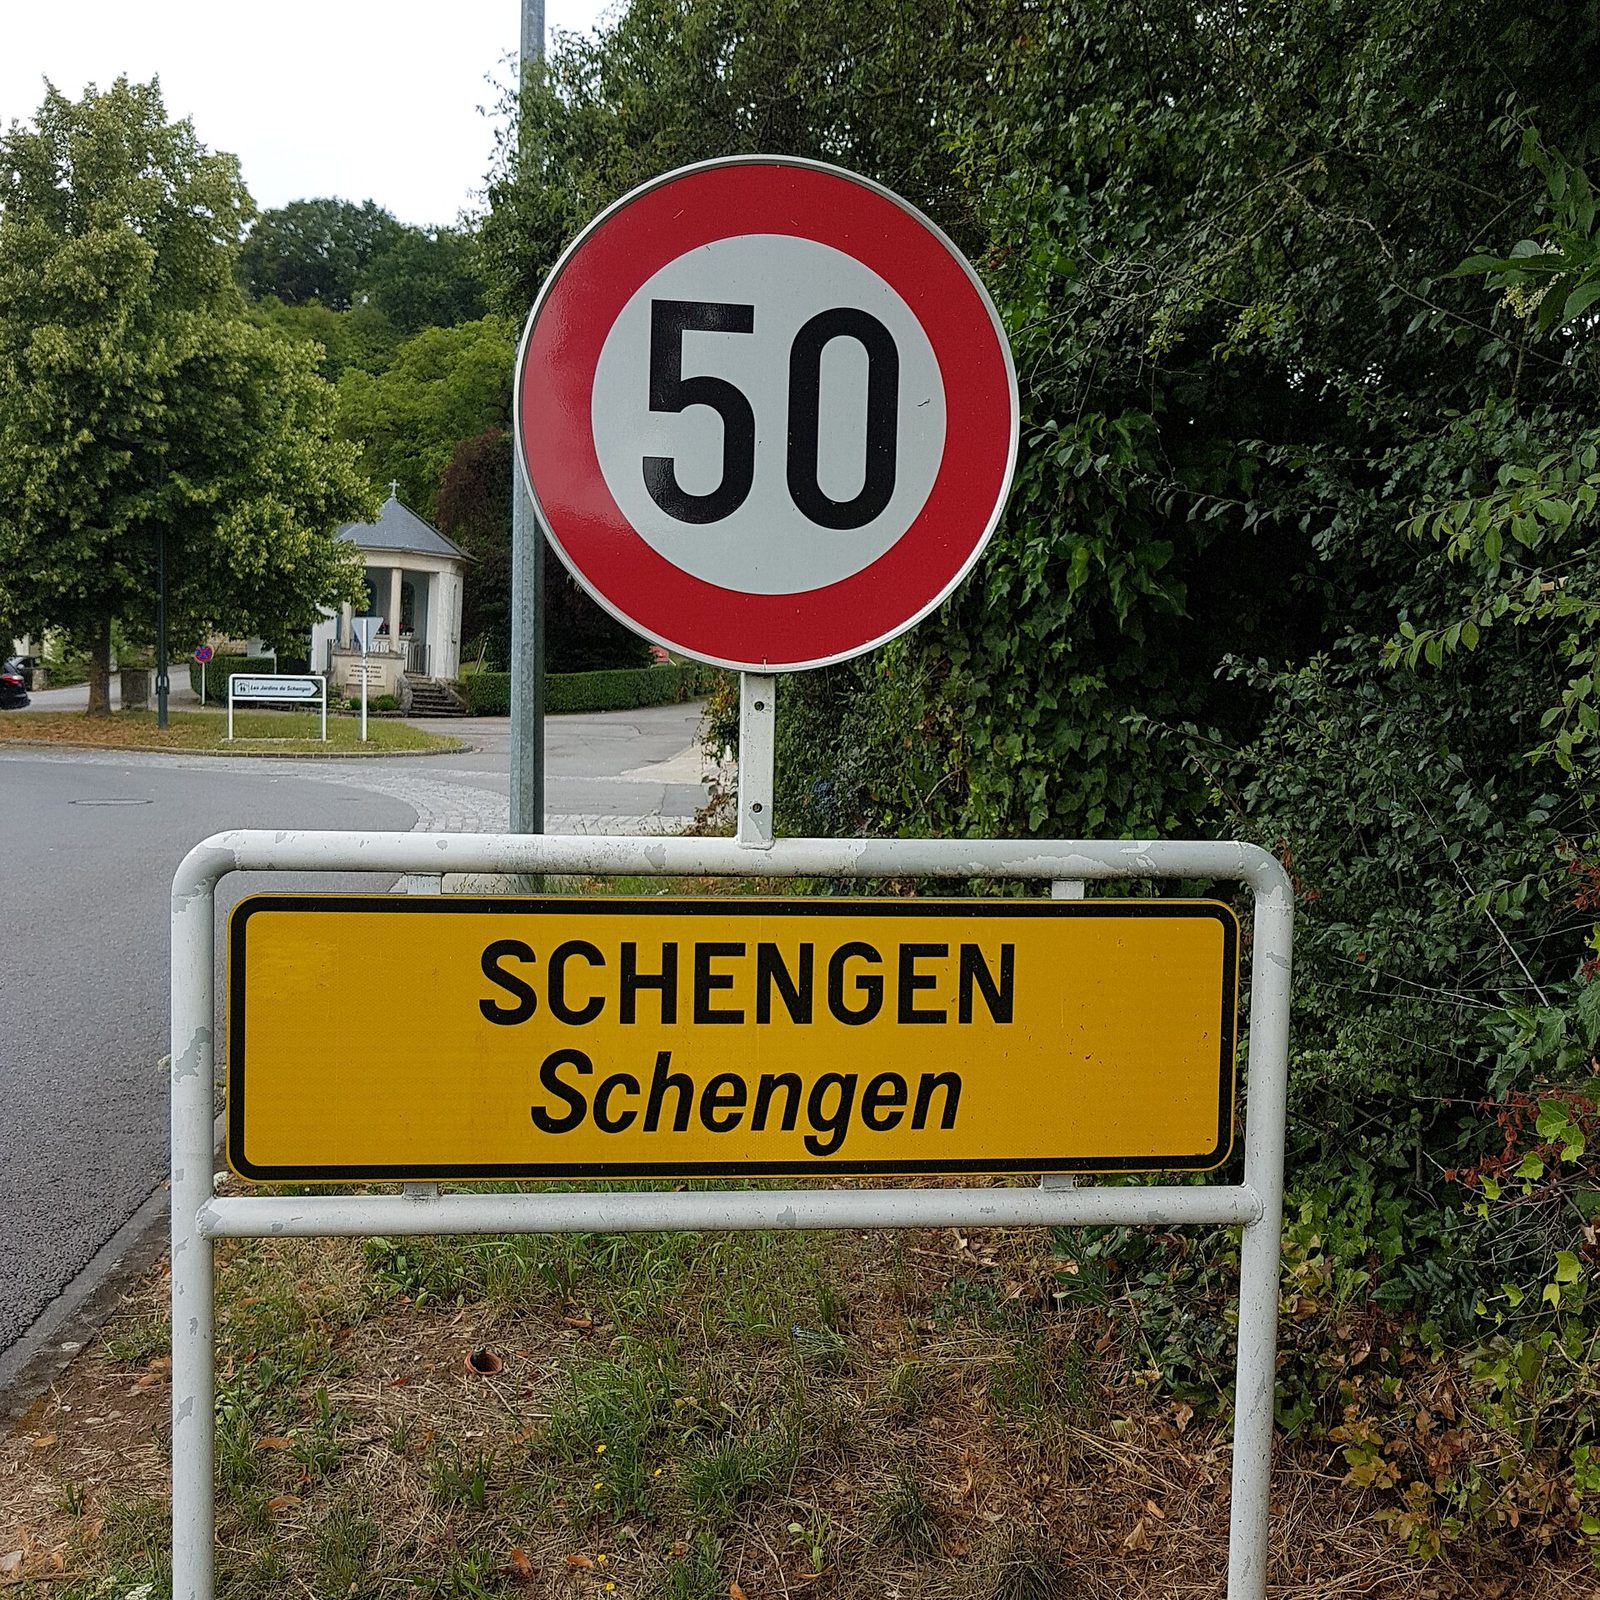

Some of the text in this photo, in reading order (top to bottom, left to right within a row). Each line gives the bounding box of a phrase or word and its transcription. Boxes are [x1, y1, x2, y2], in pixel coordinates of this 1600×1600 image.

[642, 299, 900, 530] 50
[287, 685, 312, 693] Schengen
[479, 940, 1015, 1025] SCHENGEN
[531, 1049, 962, 1158] Schengen
